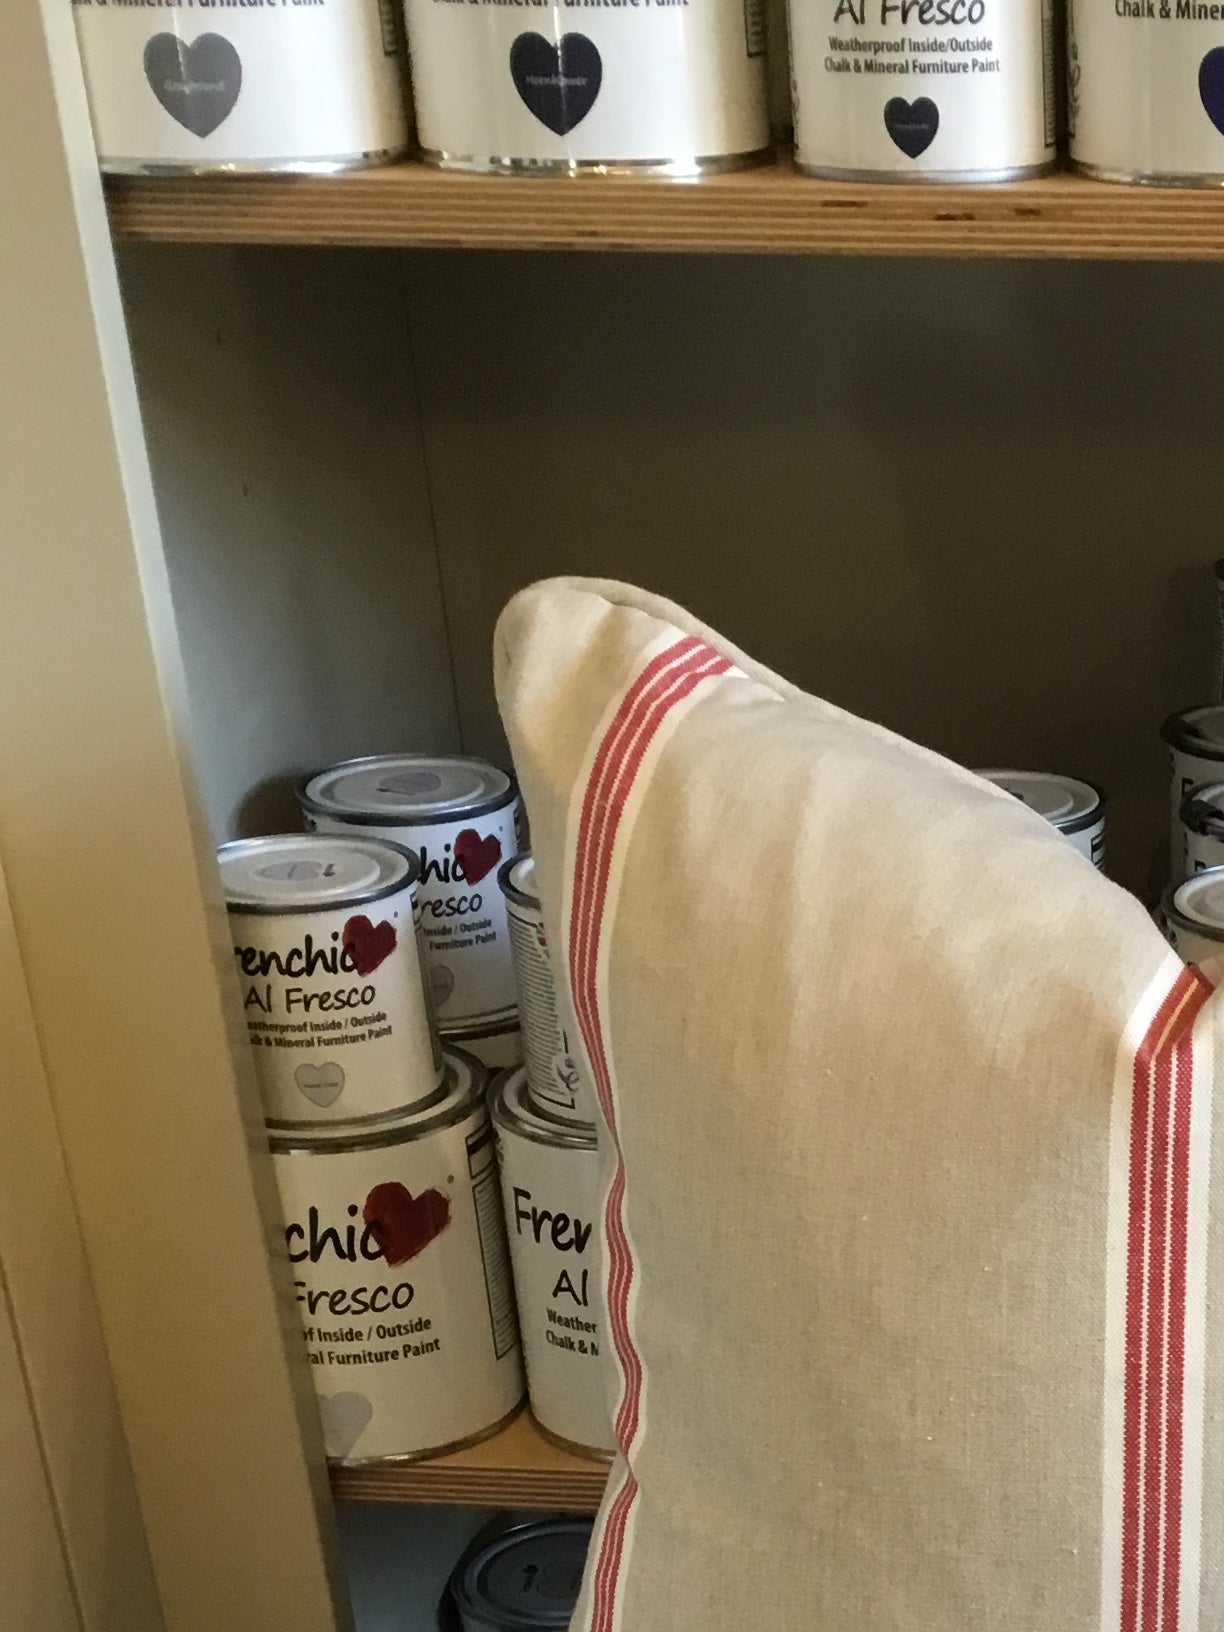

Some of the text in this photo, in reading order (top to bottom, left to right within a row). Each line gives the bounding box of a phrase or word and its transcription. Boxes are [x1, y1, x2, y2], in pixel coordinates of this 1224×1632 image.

[833, 0, 985, 25] Al Fresco
[1115, 0, 1155, 19] Chalk
[1159, 2, 1171, 19] &
[829, 36, 993, 55] Weatherproof Inside/Outside
[824, 57, 1001, 74] Chalk & Mineral Furniture Paint
[421, 893, 483, 917] resco
[234, 931, 358, 978] enchic
[244, 984, 375, 1014] Al Fresco
[309, 1020, 342, 1032] Inside
[350, 1011, 387, 1027] Outside
[274, 1036, 315, 1048] Mineral
[316, 1033, 366, 1047] Furniture
[367, 1024, 392, 1040] Paint
[552, 1269, 588, 1307] Al
[317, 1327, 364, 1343] Inside
[376, 1317, 432, 1340] Outside
[546, 1308, 597, 1333] Weather
[328, 1349, 400, 1366] Furniture
[402, 1338, 441, 1359] Paint
[546, 1330, 576, 1351] Chalk
[578, 1341, 588, 1354] &
